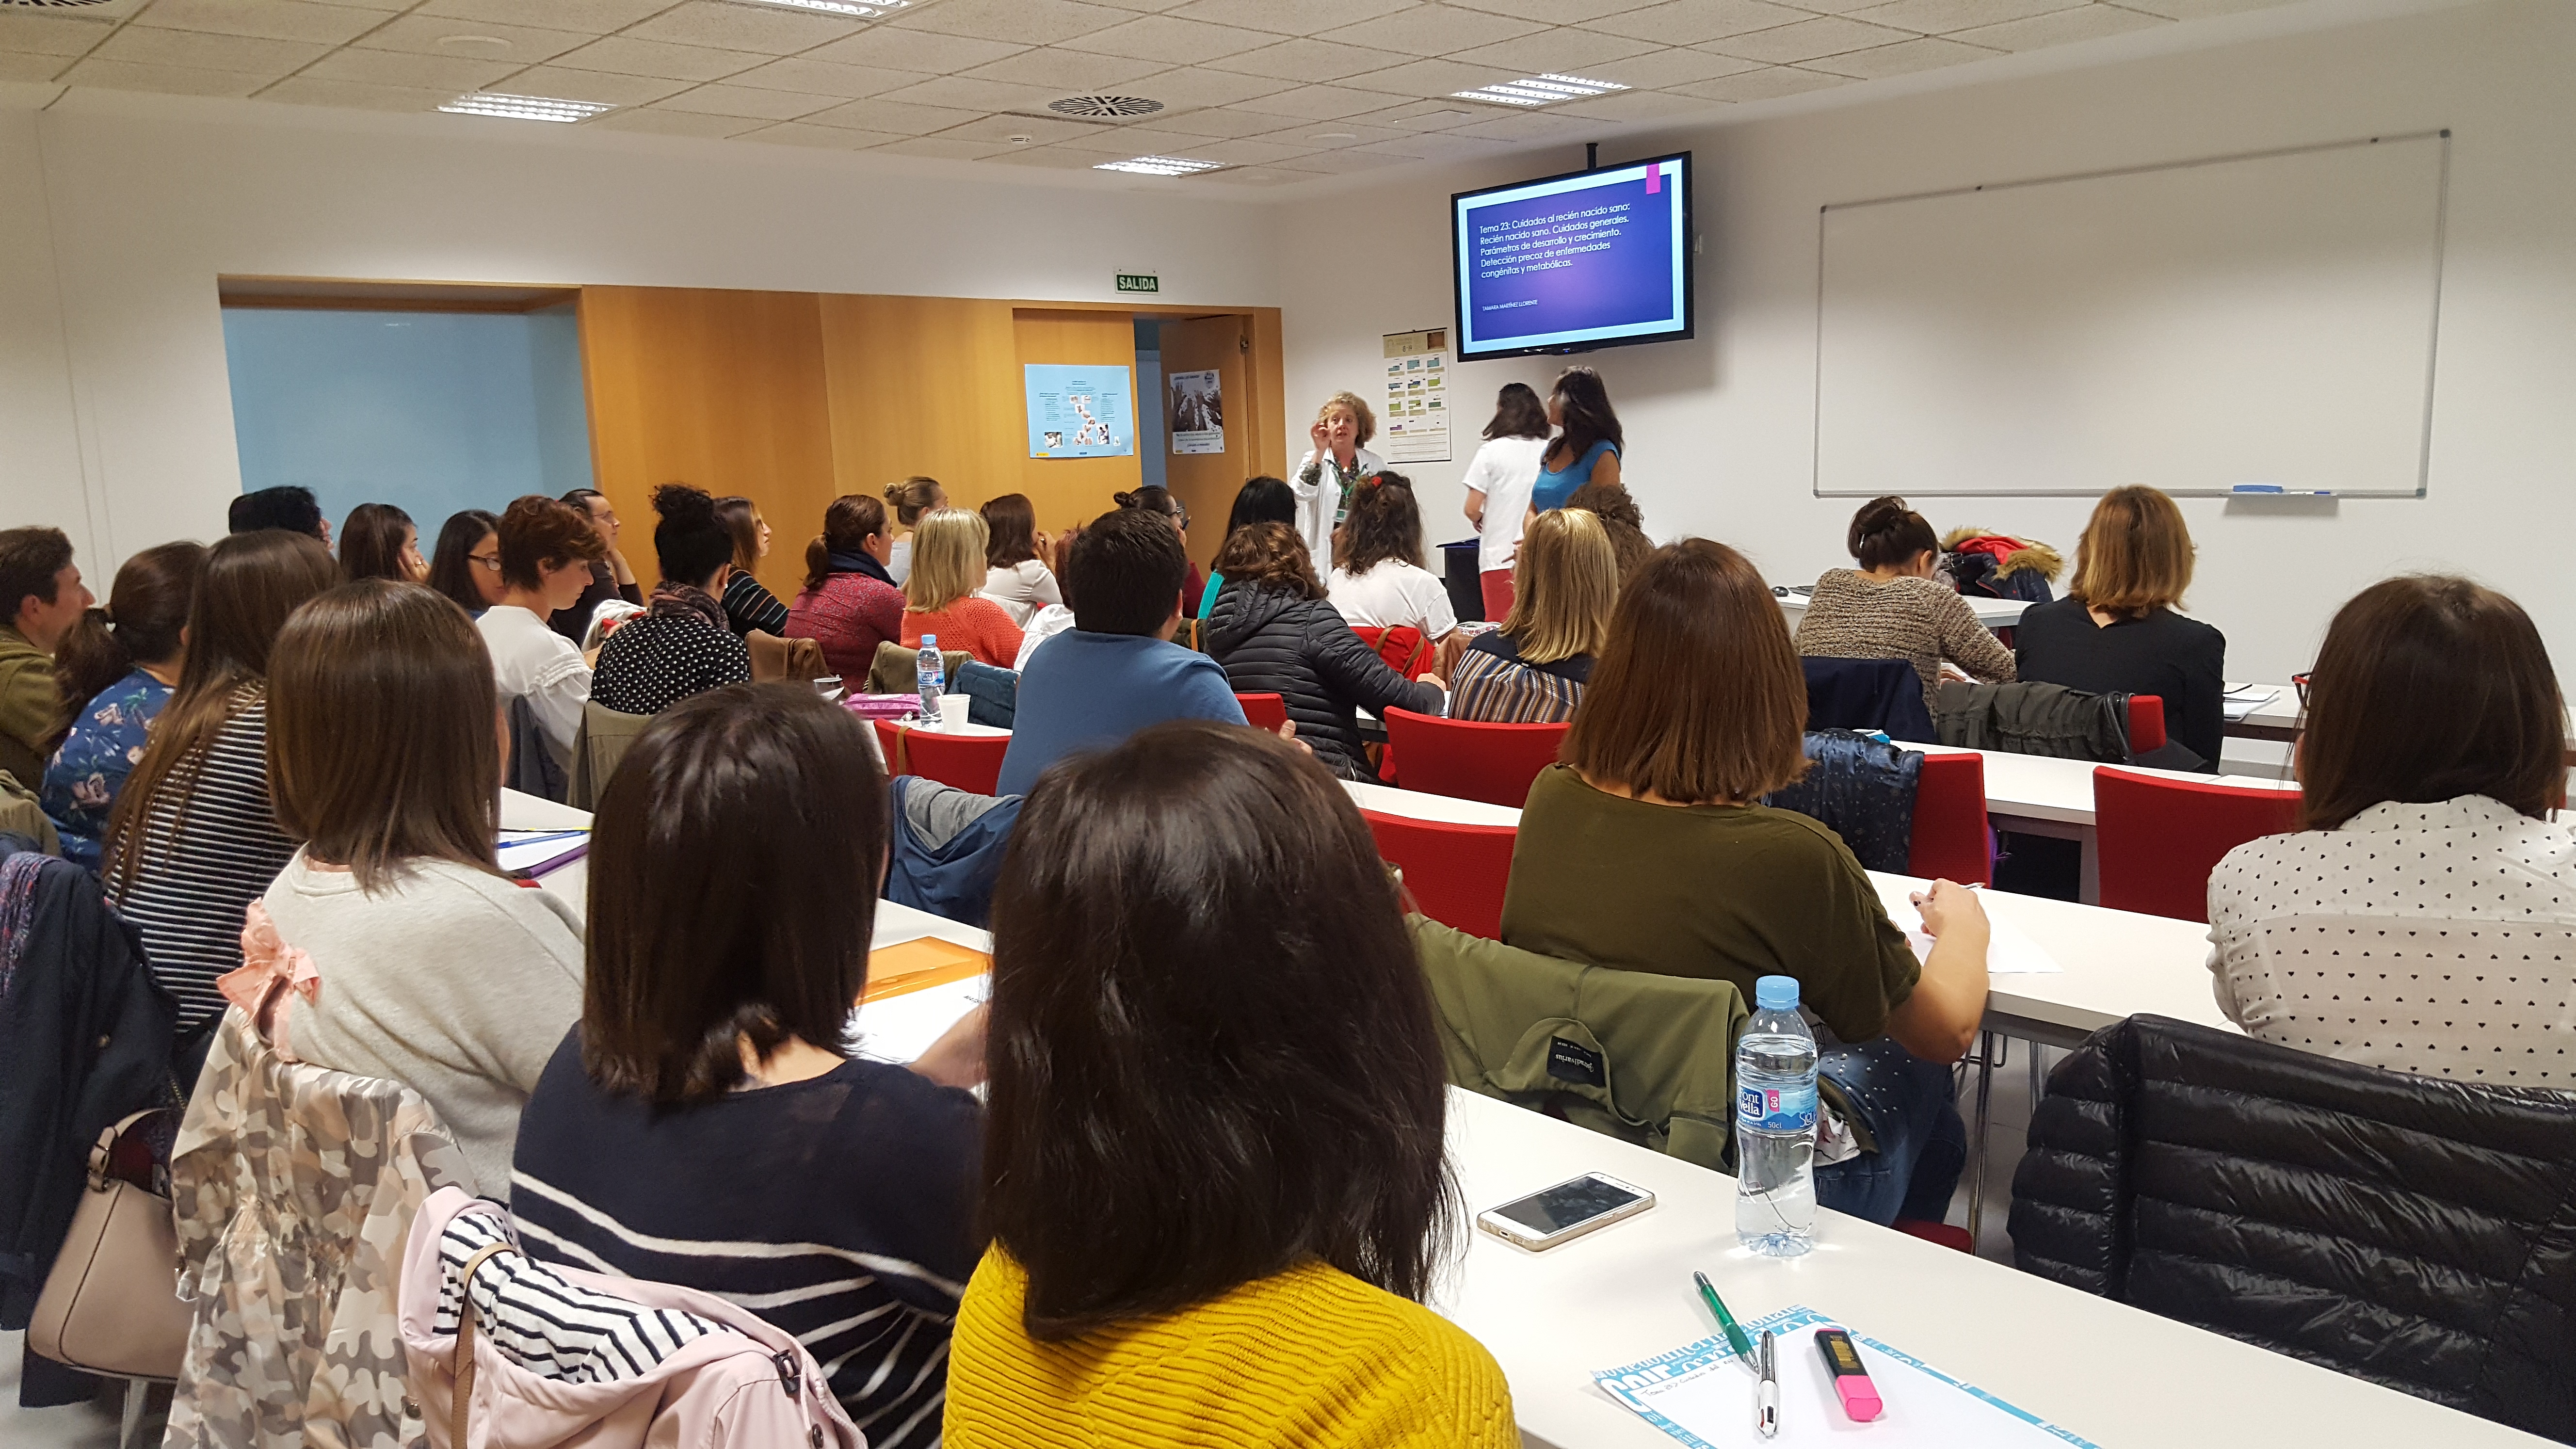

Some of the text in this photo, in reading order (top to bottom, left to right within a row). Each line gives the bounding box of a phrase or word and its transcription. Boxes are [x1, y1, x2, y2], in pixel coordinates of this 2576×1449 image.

[1480, 203, 1630, 234] Tema 23: Cuidados al recién nacido sano:
[1480, 215, 1629, 245] Recién nacido sano. Cuidados generales.
[1481, 228, 1621, 256] Parámetros de desarrollo y crecimiento.
[1481, 242, 1610, 267] Detección precoz de enfermedades
[1481, 267, 1519, 278] congénitas
[1527, 259, 1573, 272] metabólicas.
[1119, 277, 1156, 290] SALIDA
[1739, 1086, 1759, 1104] Font
[1770, 1096, 1778, 1108] GO
[1739, 1098, 1760, 1116] Vella
